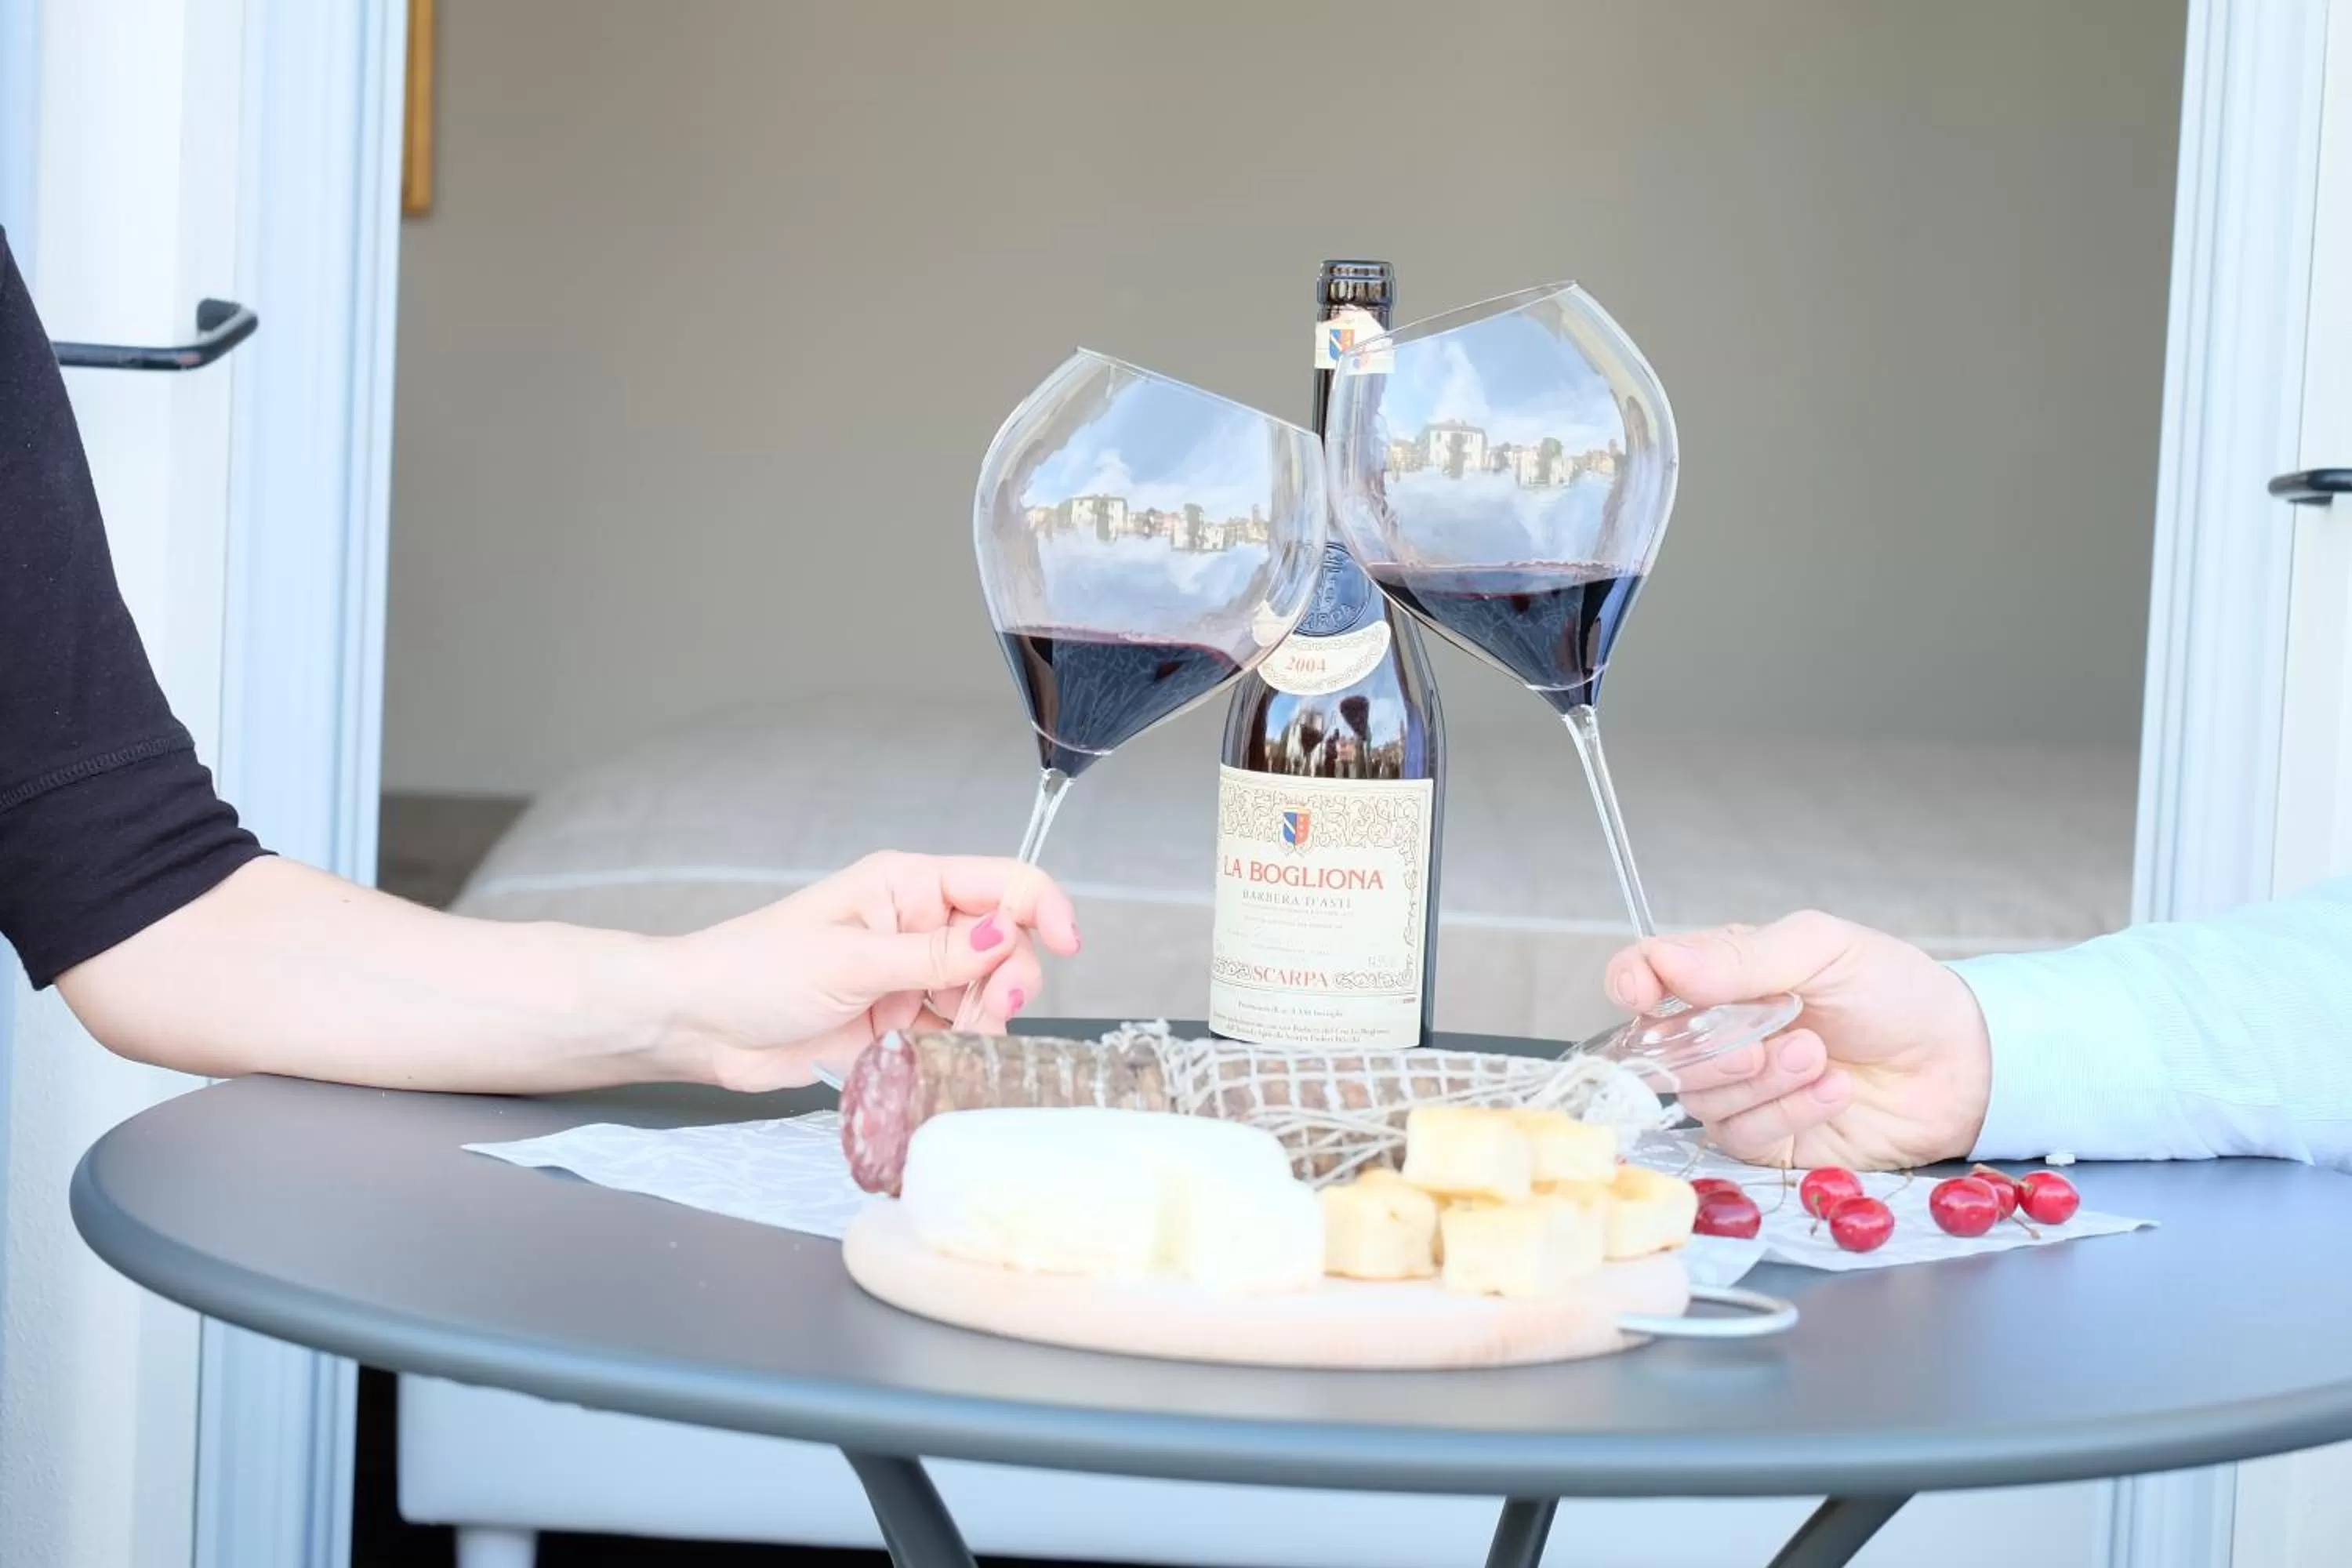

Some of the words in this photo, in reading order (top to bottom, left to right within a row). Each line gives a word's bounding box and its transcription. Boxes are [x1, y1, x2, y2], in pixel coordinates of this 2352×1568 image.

[1286, 655, 1327, 673] 2004
[1223, 855, 1242, 879] LA
[1250, 860, 1384, 891] BOGLIONA
[1243, 890, 1299, 905] BARBERA
[1305, 897, 1352, 909] D'ASTI
[1252, 966, 1328, 988] SCARPA
